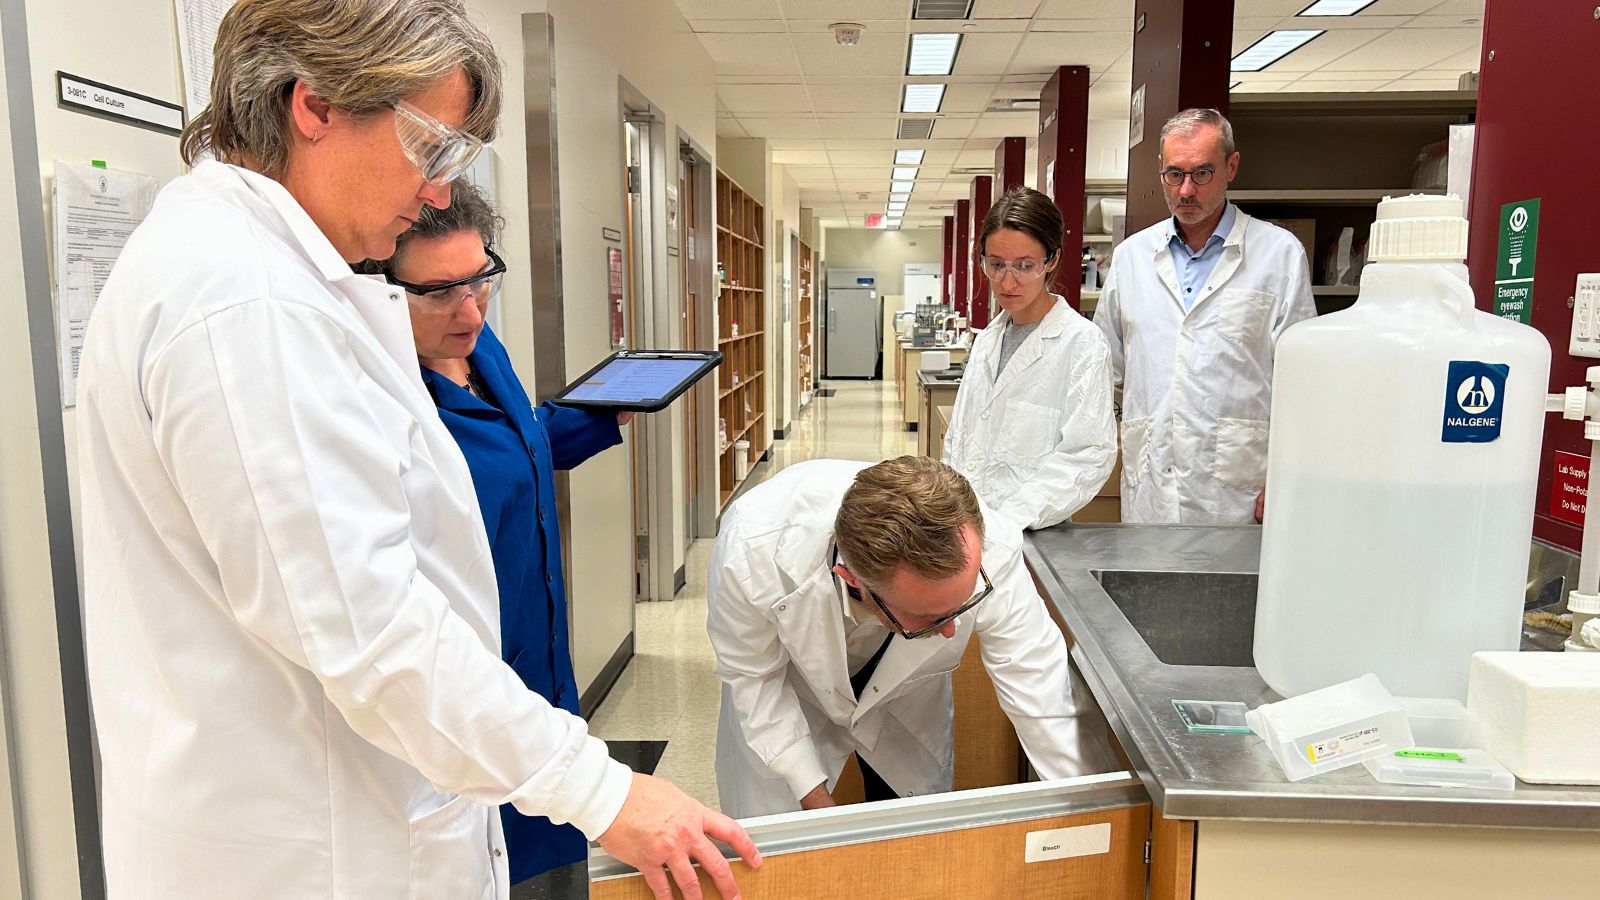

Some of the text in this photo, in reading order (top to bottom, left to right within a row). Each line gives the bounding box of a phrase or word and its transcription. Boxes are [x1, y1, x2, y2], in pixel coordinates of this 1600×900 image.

[67, 86, 125, 109] 3-081C Cell Culture
[1498, 287, 1528, 299] Emergency
[1500, 299, 1524, 313] eyewash
[1447, 417, 1496, 427] NALGENE
[1558, 463, 1587, 480] Lab Supply
[1563, 482, 1588, 497] Non-Pota
[1561, 499, 1586, 514] Do Not D
[1042, 844, 1061, 852] Bleach
